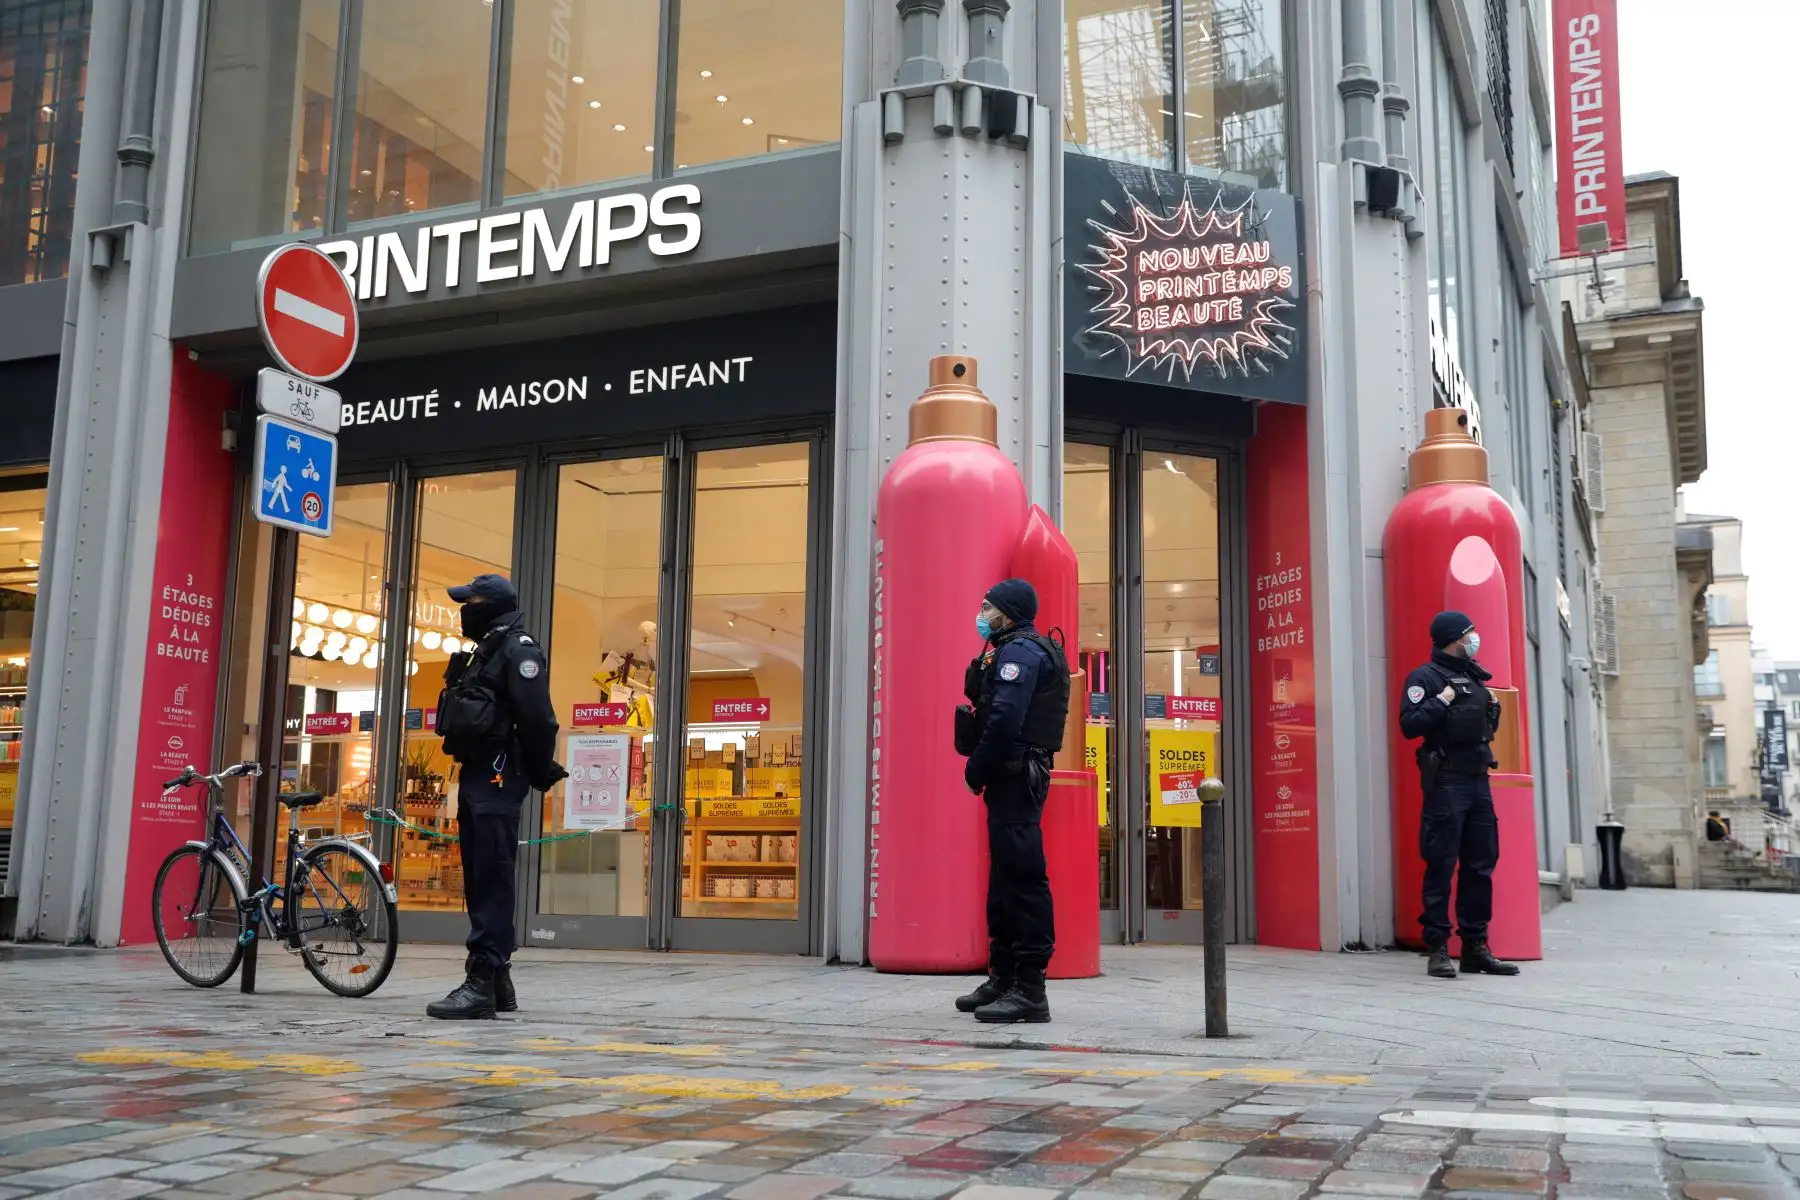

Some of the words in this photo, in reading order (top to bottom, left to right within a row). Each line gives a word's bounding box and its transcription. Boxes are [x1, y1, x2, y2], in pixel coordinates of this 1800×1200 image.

[1569, 13, 1608, 217] PRINTEMPS
[314, 183, 702, 301] RINTEMPS
[1139, 241, 1270, 273] NOUVEAU
[1139, 265, 1293, 302] PRINTEMPS
[1136, 296, 1243, 332] BEAUTÉ
[288, 380, 321, 401] SAUF
[340, 389, 440, 427] BEAUTÉ
[476, 376, 588, 412] MAISON
[629, 356, 753, 395] ENFANT
[306, 499, 318, 513] 20
[1275, 552, 1281, 566] 3
[187, 573, 193, 586] 3
[1257, 566, 1302, 591] ÉTAGES
[162, 585, 213, 609] ÉTAGES
[162, 605, 210, 627] DÉDIÉS
[1267, 613, 1275, 630] À
[1279, 611, 1294, 627] LA
[170, 623, 179, 640] À
[183, 628, 200, 644] LA
[1258, 626, 1304, 652] BEAUTÉ
[157, 642, 209, 663] BEAUTÉ
[575, 706, 610, 717] ENTRÉE
[714, 702, 752, 713] ENTRÉE
[1172, 699, 1216, 712] ENTRÉE
[307, 716, 337, 726] ENTRÉE
[1160, 749, 1206, 762] SOLDES
[762, 801, 788, 809] SOLDES
[869, 747, 881, 918] PRINTEMPS
